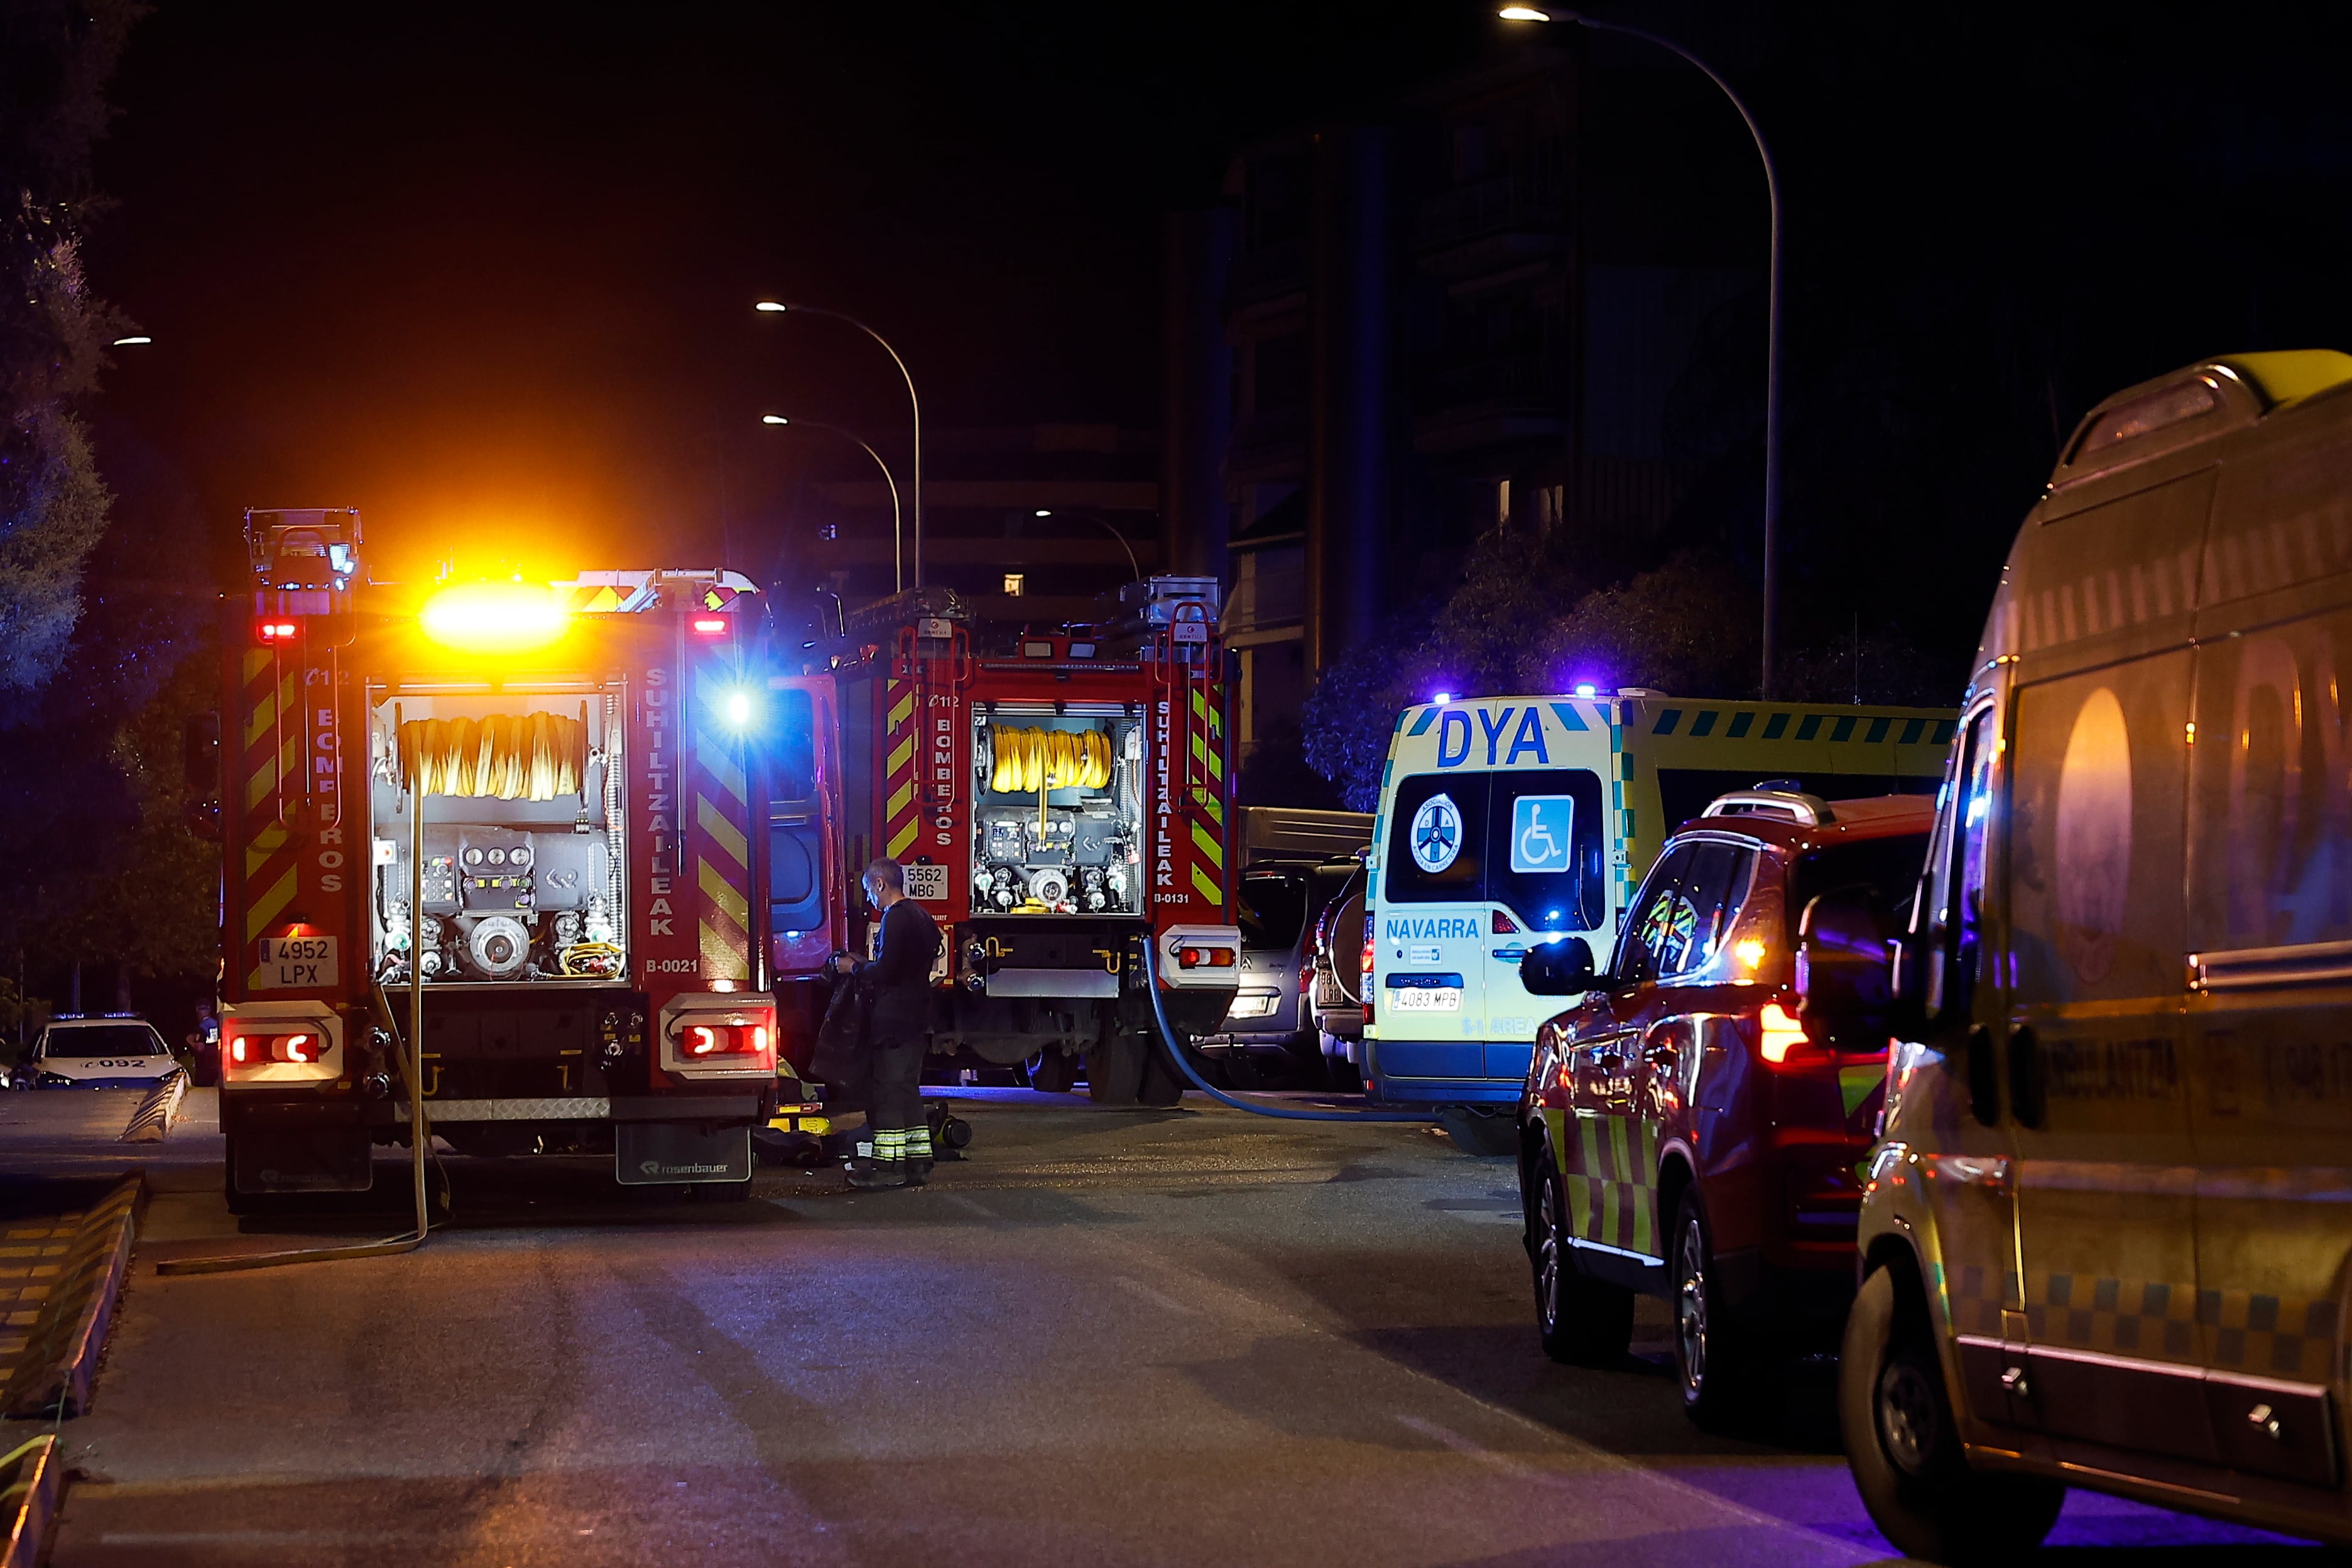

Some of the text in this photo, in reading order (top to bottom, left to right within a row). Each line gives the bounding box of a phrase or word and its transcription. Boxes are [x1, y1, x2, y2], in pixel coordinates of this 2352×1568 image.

[939, 696, 960, 707] 112
[1437, 707, 1550, 768] DYA
[934, 719, 953, 846] BOMBEROS
[645, 668, 674, 936] SUHILTZAILEAK
[1156, 701, 1173, 886] SUHILTZAILEAK
[1413, 846, 1424, 867] AYUDA
[1432, 844, 1459, 871] CARRETERA
[907, 868, 942, 881] 5562
[908, 884, 934, 897] MBG
[1386, 918, 1479, 939] NAVARRA
[278, 940, 328, 959] 4952
[280, 964, 318, 984] LPX
[646, 959, 699, 973] B-0021
[1402, 993, 1457, 1006] 4083 MPB
